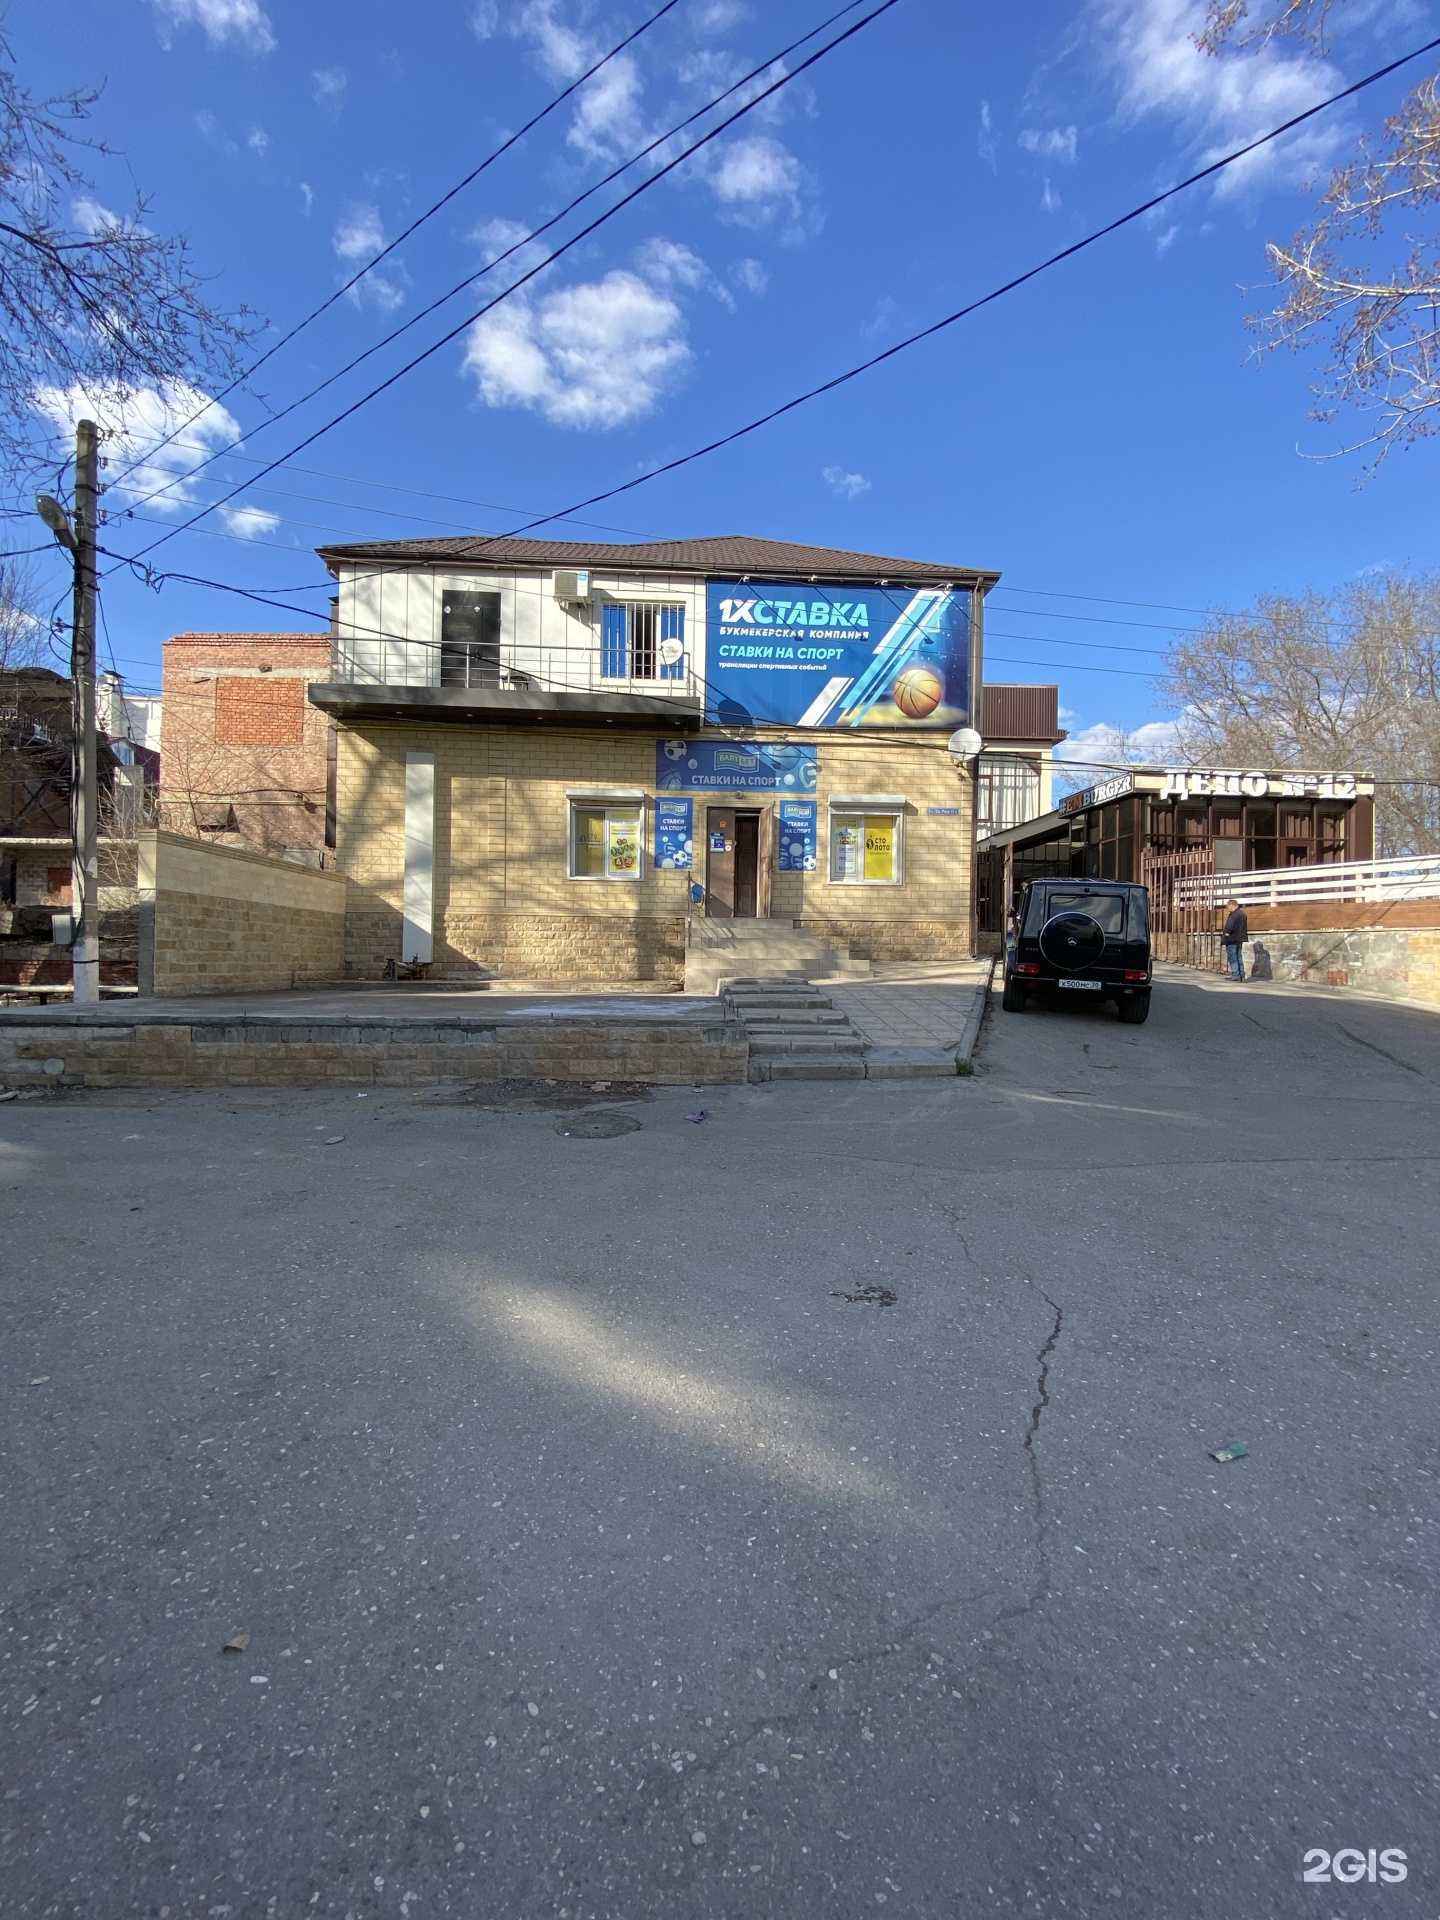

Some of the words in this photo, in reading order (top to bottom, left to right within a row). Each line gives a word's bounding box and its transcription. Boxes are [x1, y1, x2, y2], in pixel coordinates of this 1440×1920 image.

[719, 626, 804, 638] БУКМЕКЕРСКАЯ
[809, 630, 870, 640] КОМПАНИЯ
[719, 645, 773, 659] СТАВКИ
[775, 647, 794, 660] НА
[797, 647, 844, 661] СПОРТ
[798, 663, 828, 671] событий
[692, 774, 731, 785] СТАВКИ
[732, 775, 746, 786] НА
[748, 776, 781, 787] СПОРТ
[1160, 768, 1269, 800] ДЕПО
